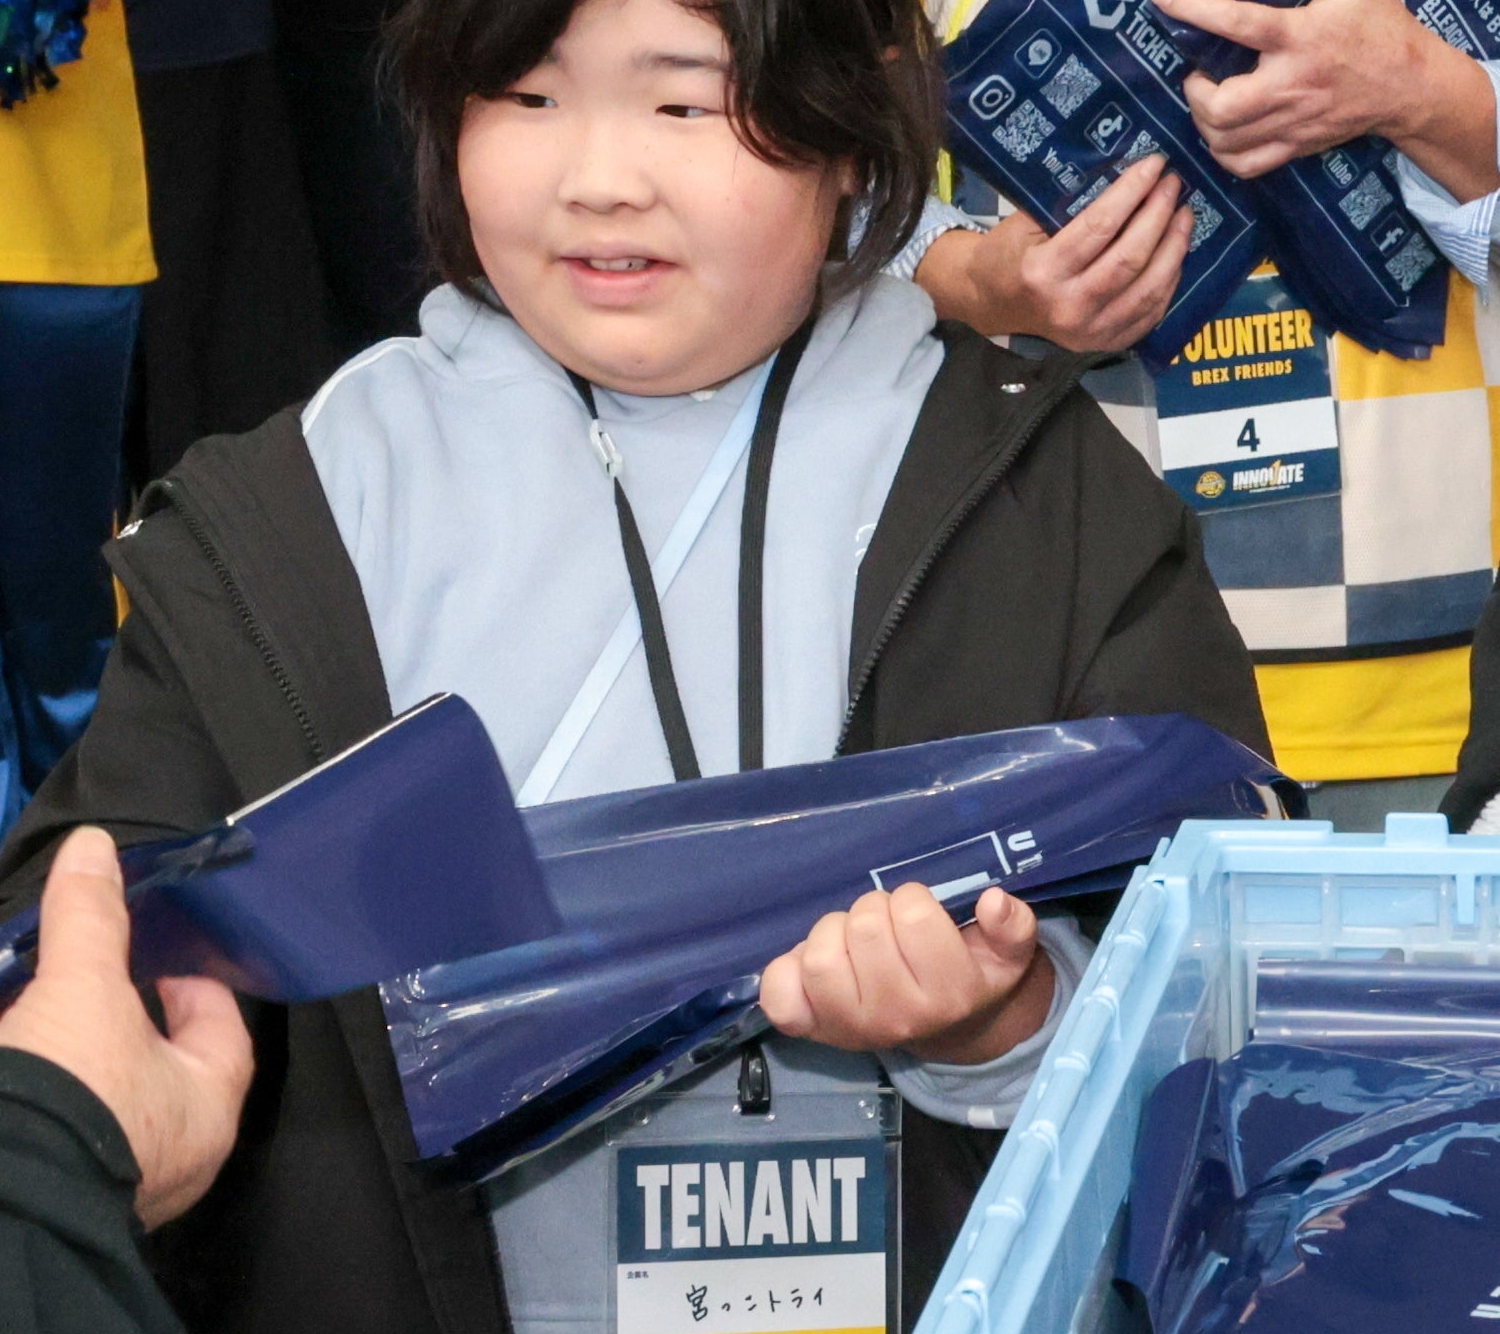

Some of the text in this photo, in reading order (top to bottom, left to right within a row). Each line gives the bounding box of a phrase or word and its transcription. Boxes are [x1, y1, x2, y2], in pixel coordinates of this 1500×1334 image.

[1129, 8, 1186, 79] TICKET
[1171, 309, 1315, 365] OLUNTEER
[1192, 359, 1292, 387] BREX FRIENDS
[1236, 418, 1261, 452] 4
[636, 1157, 867, 1250] TENANT
[686, 1284, 823, 1321] 宮っこトライ
